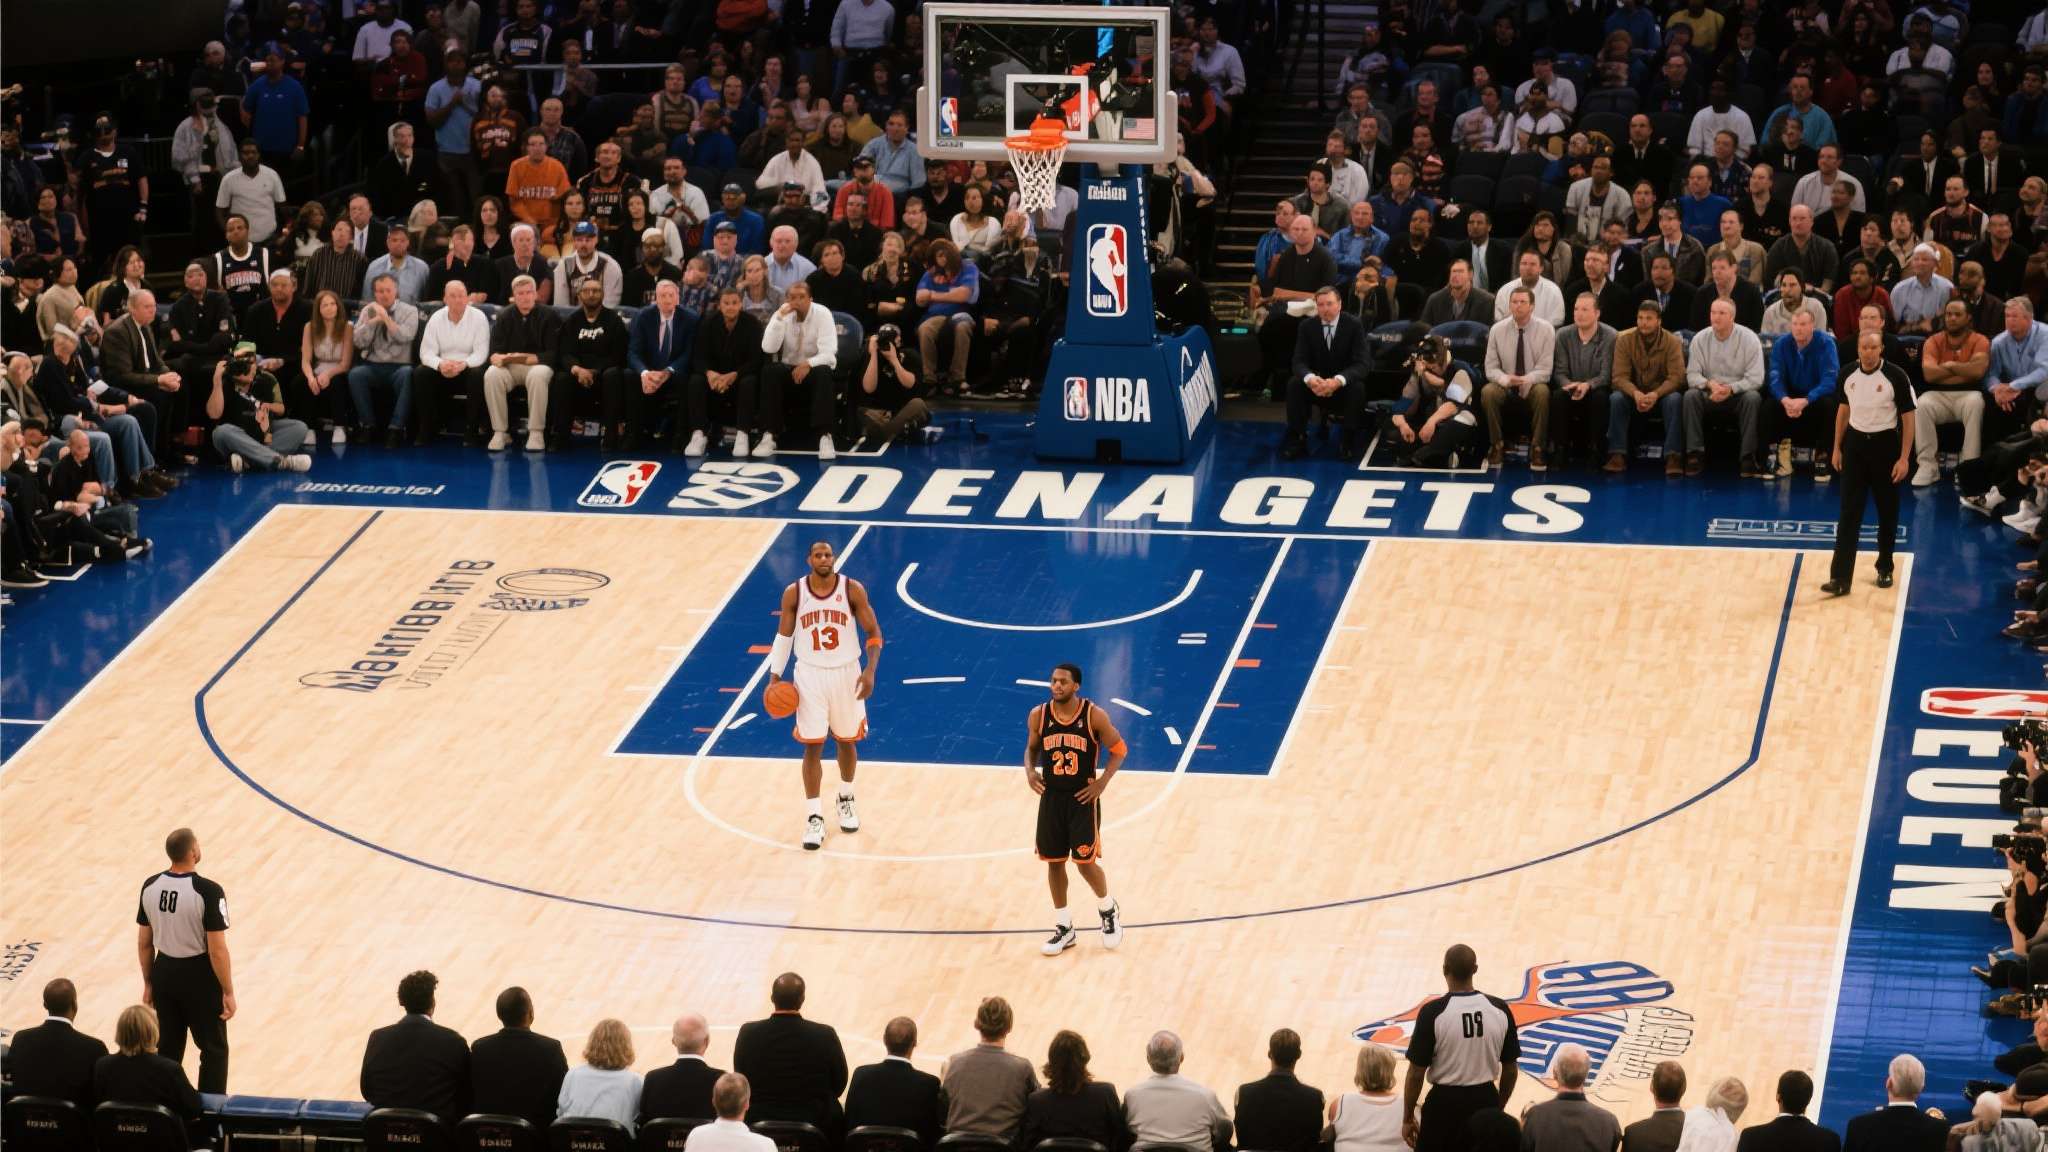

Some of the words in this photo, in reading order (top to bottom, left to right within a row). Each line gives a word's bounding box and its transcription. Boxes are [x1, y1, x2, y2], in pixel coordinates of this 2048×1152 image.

[1095, 377, 1151, 422] NBA
[798, 465, 1592, 534] DENAGETS
[811, 626, 839, 651] 13
[1052, 751, 1079, 775] 23
